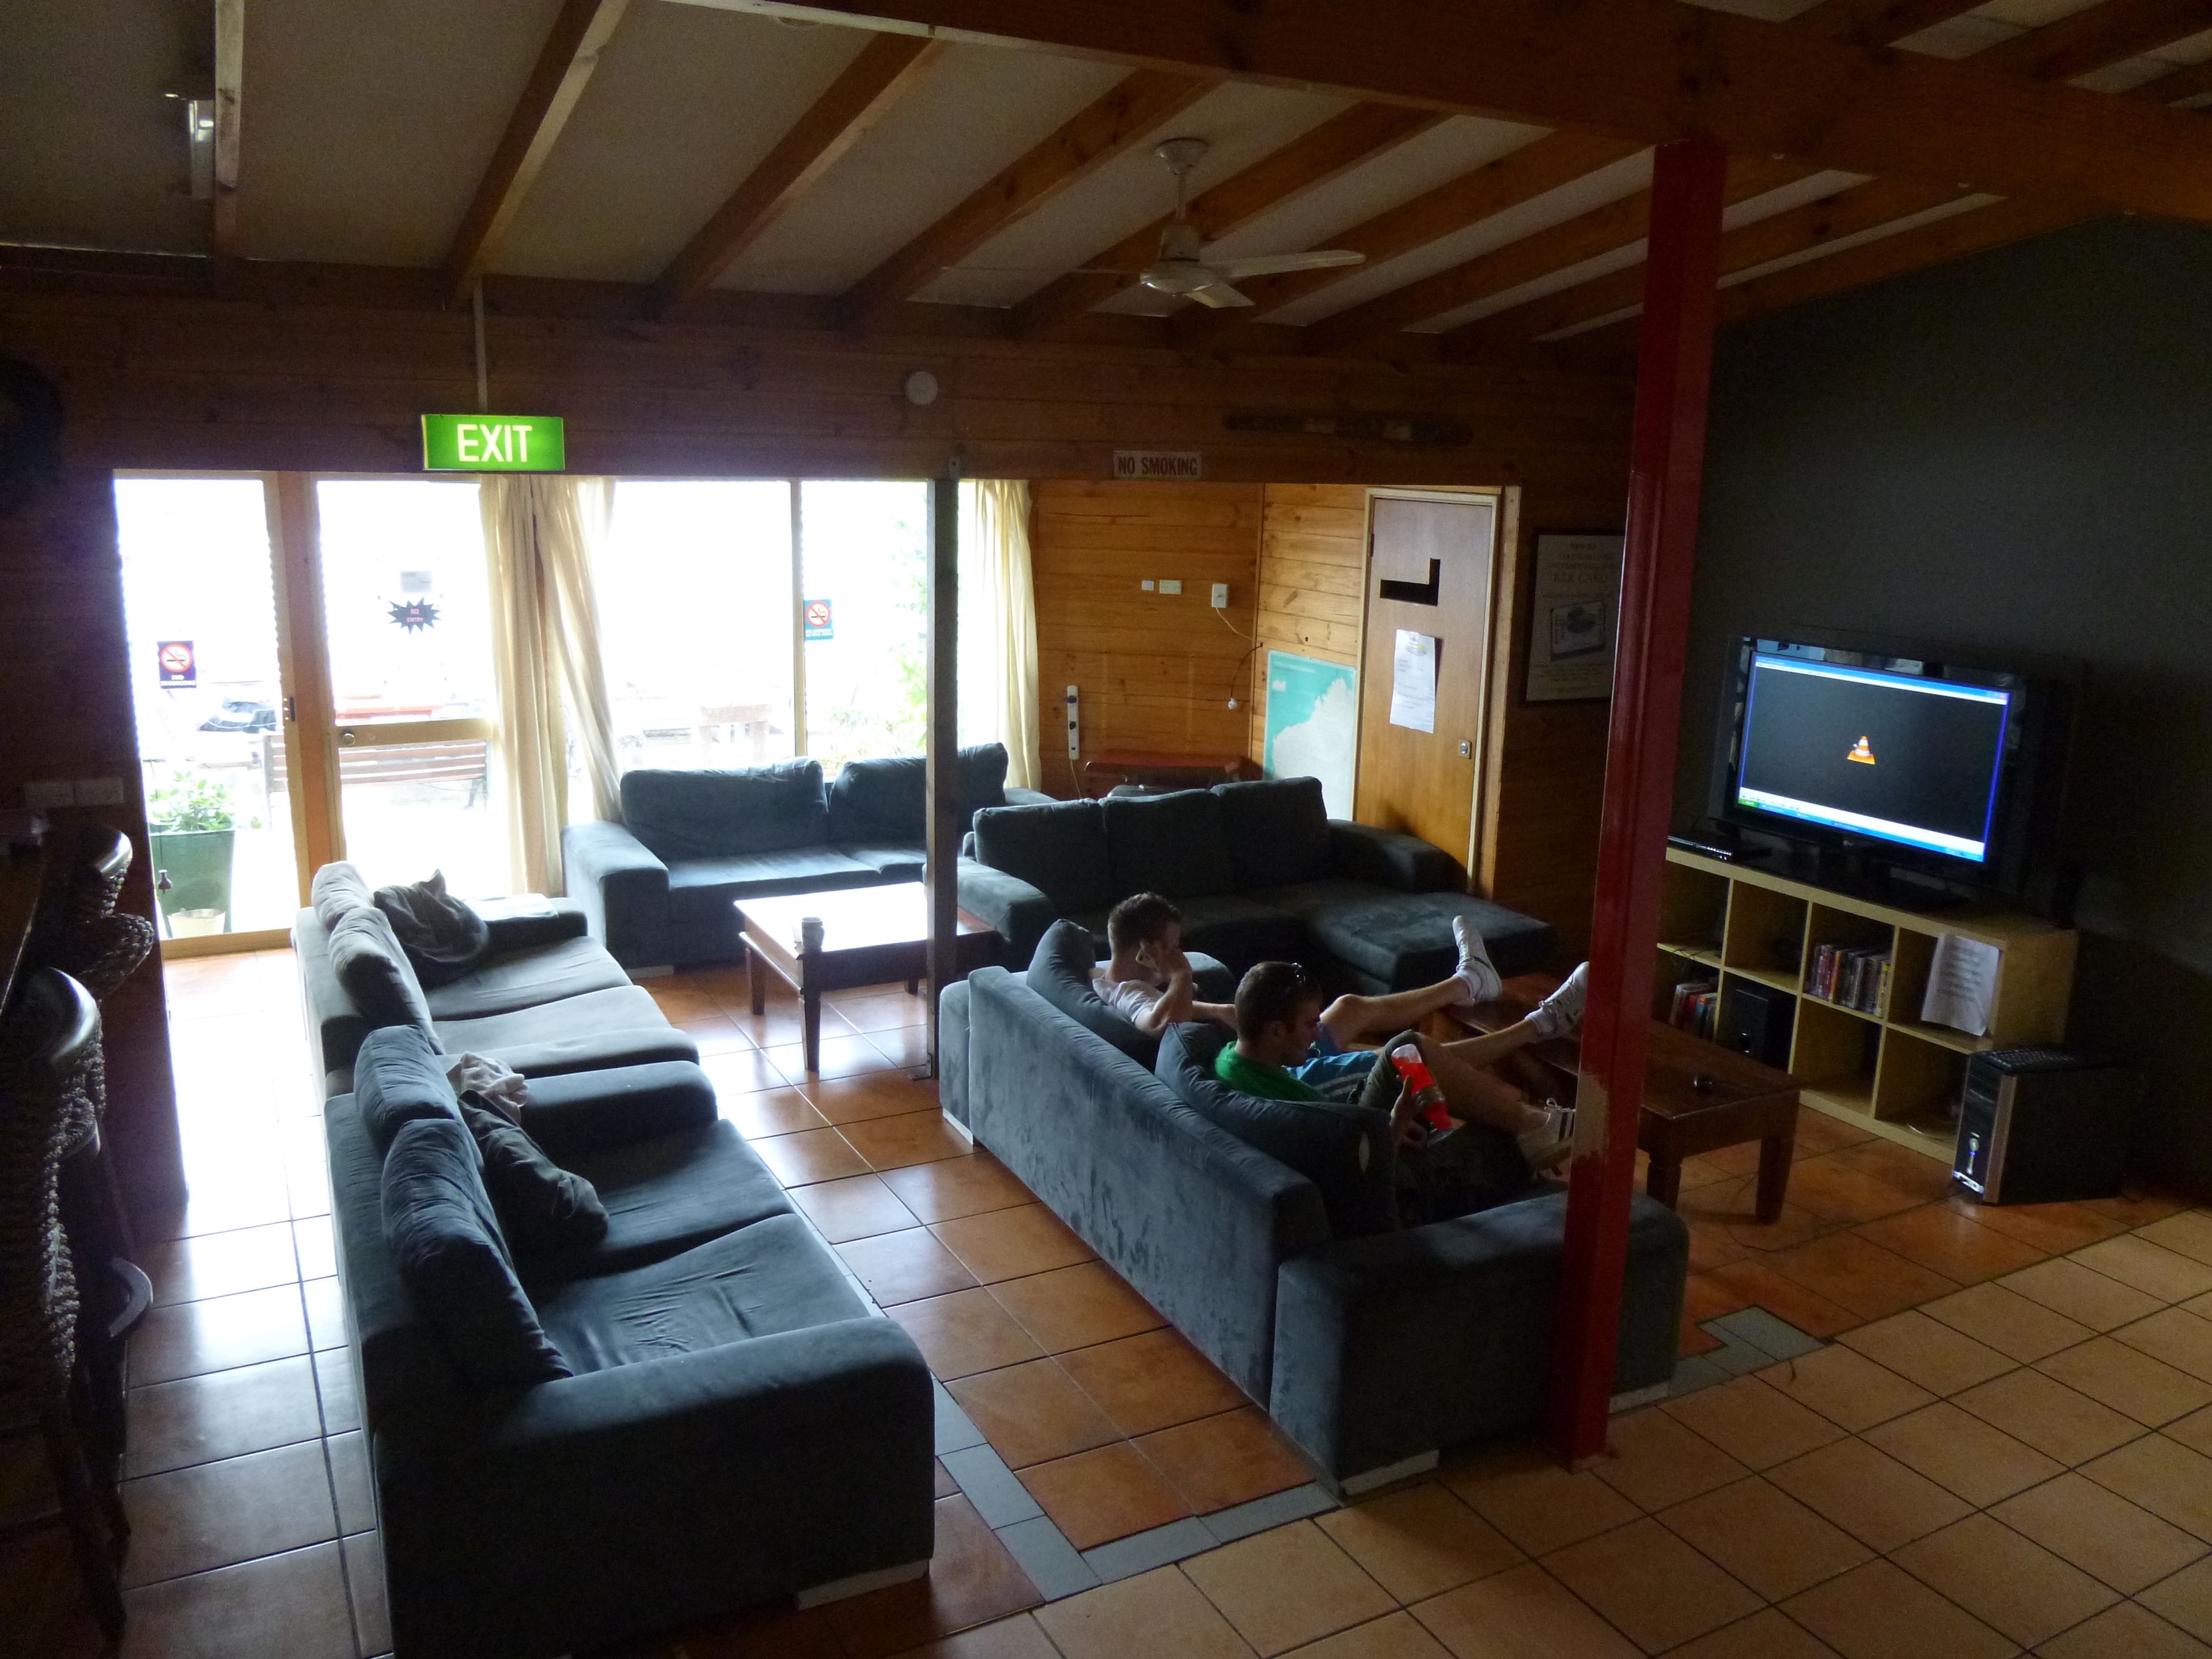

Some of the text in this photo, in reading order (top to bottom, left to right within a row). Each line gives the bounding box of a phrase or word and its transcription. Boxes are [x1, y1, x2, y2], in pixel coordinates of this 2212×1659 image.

[457, 424, 532, 462] EXIT
[1118, 457, 1198, 476] NO SMOKING
